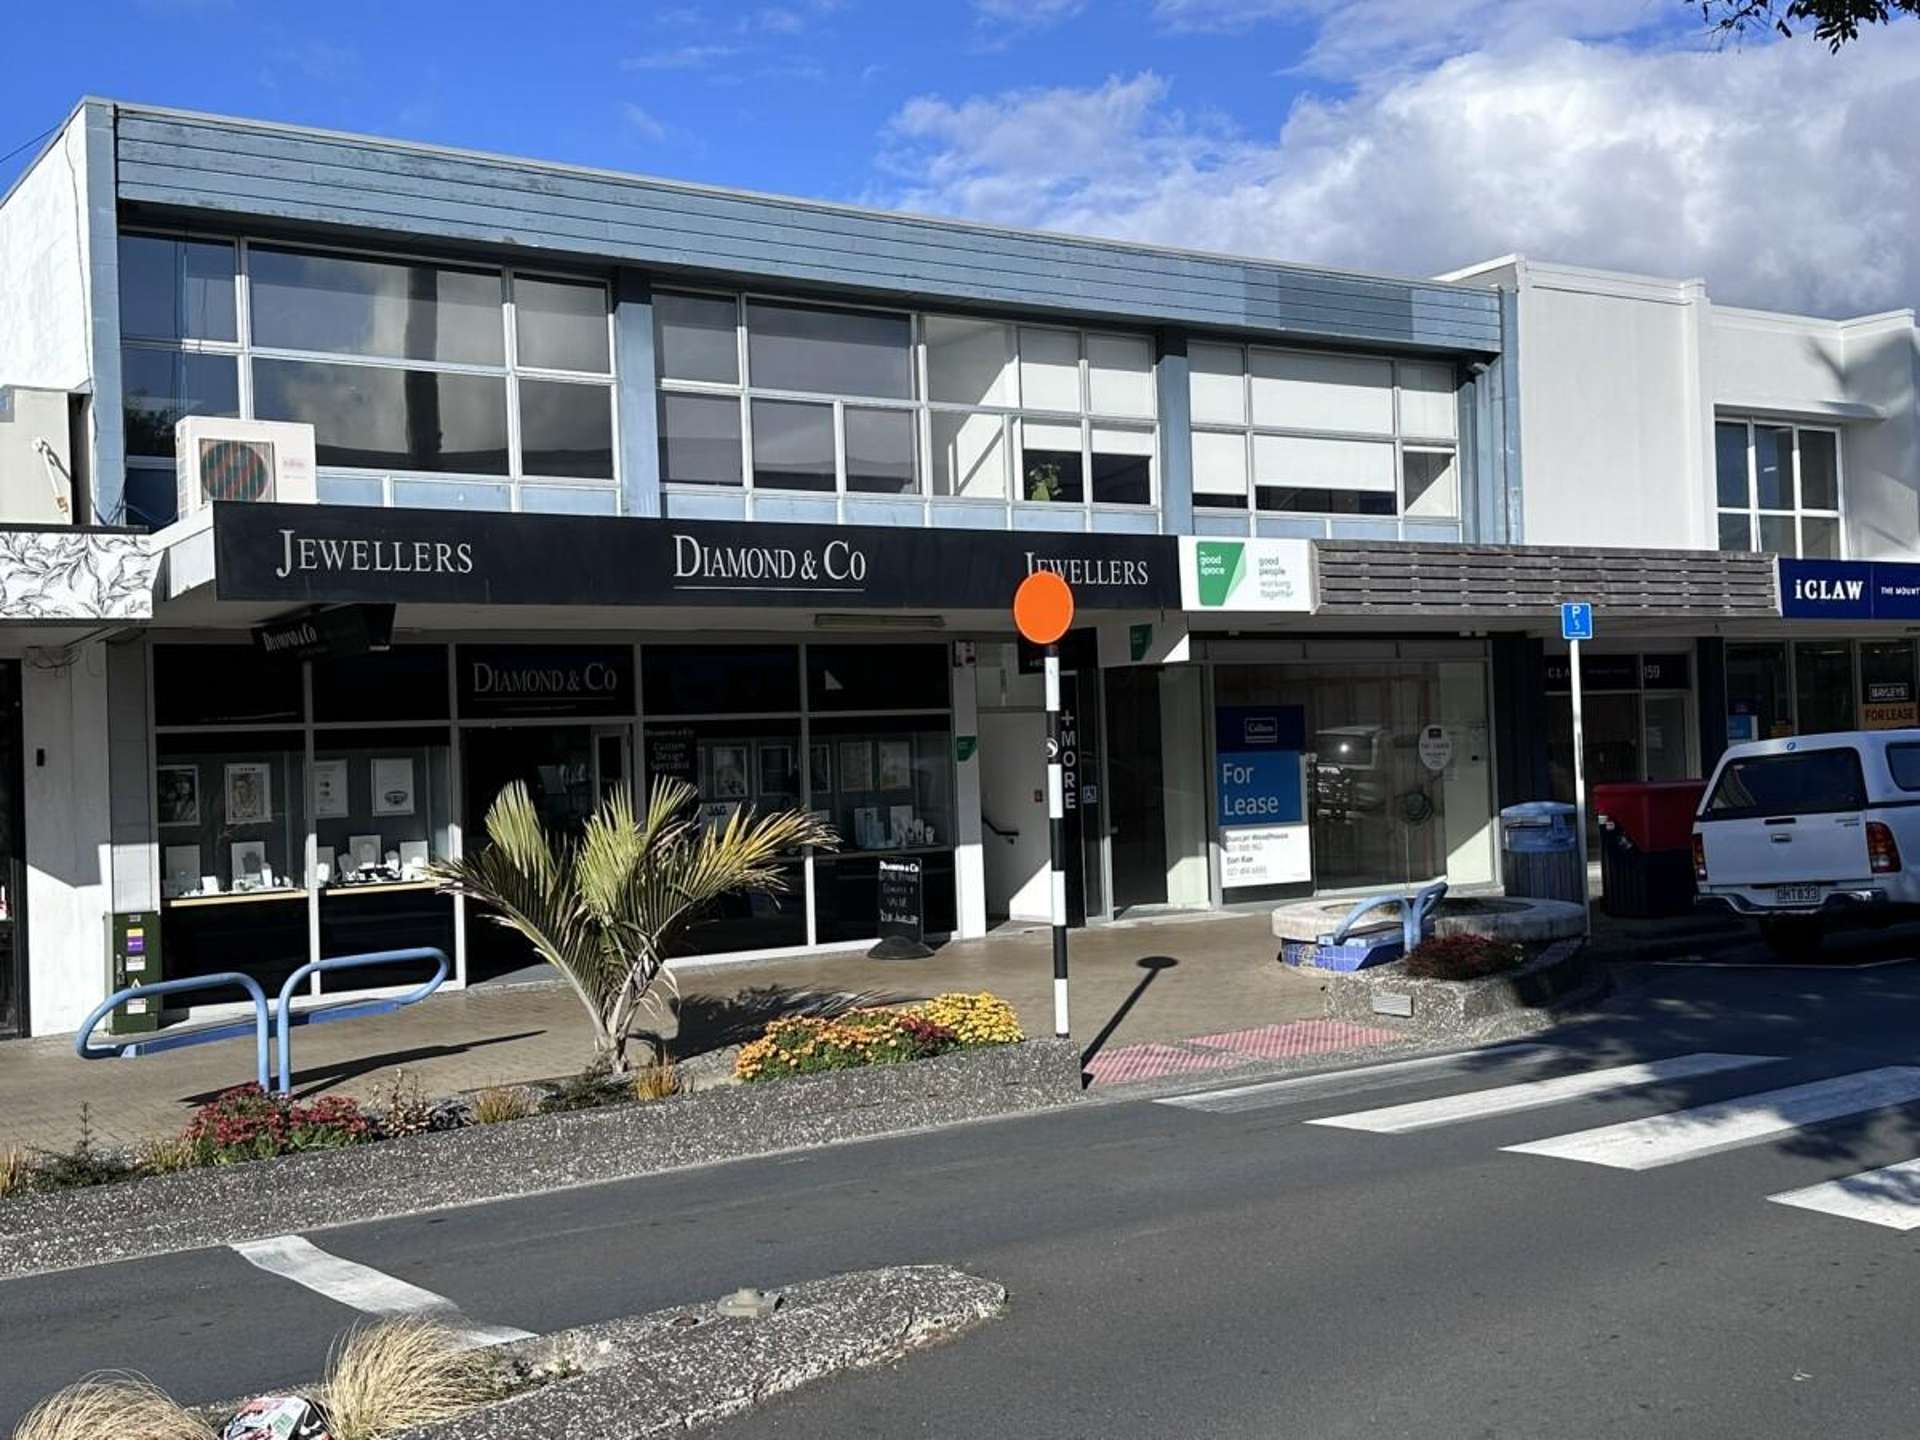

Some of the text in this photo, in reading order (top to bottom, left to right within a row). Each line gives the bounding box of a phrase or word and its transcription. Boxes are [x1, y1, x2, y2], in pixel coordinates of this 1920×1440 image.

[276, 528, 473, 578] JEWELLERS
[673, 534, 796, 579] DIAMOND
[800, 549, 818, 581] &
[1200, 555, 1222, 567] good
[1258, 556, 1280, 567] good
[1200, 567, 1226, 577] space
[1258, 567, 1286, 577] people
[1260, 580, 1291, 591] working
[1795, 578, 1865, 600] iCLAW
[1880, 586, 1893, 596] THE
[1572, 606, 1581, 620] P
[472, 661, 563, 692] DIAMOND
[567, 669, 580, 692] &
[1865, 708, 1886, 721] FOR
[1223, 763, 1255, 785] For
[1224, 794, 1279, 816] Lease
